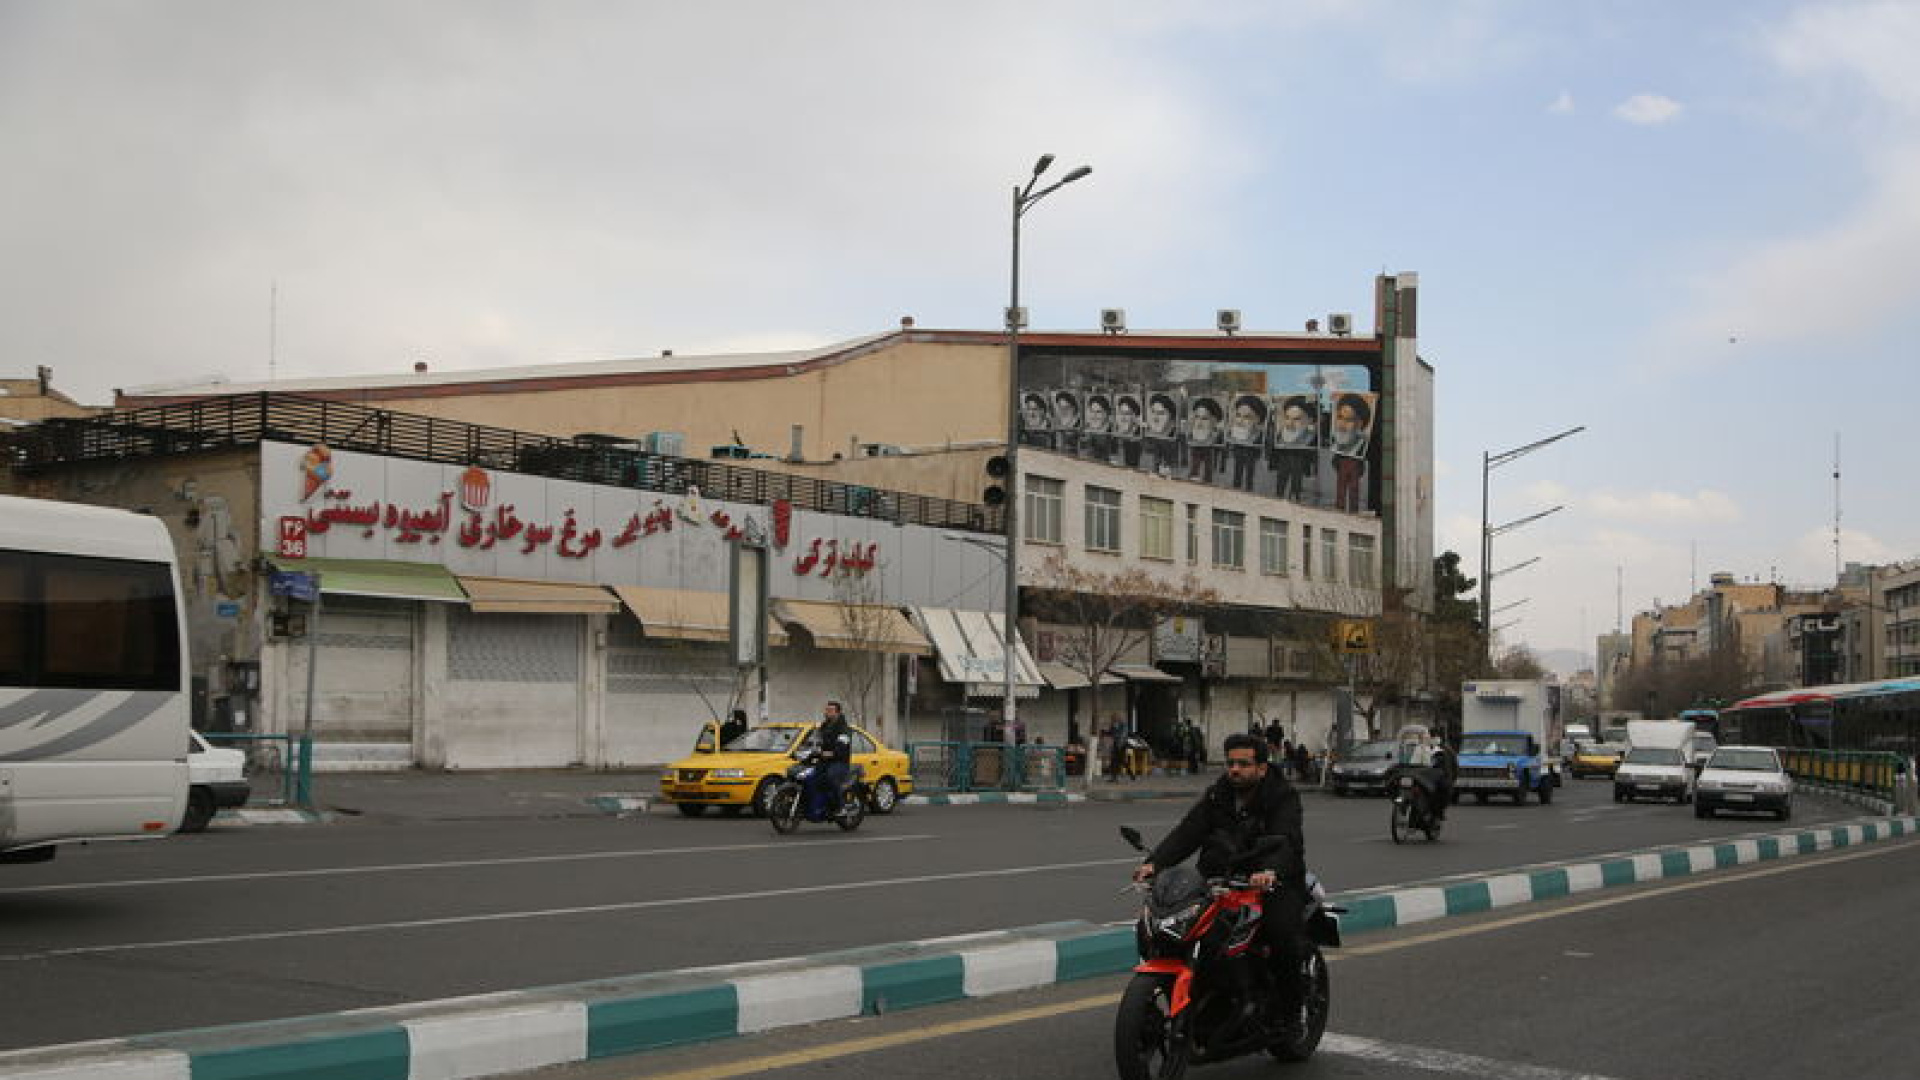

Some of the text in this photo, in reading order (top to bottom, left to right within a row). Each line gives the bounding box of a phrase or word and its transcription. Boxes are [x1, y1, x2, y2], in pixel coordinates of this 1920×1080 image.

[304, 489, 380, 540] بستنی
[458, 503, 554, 554] سوخاری
[556, 508, 602, 559] مرغ
[792, 537, 838, 577] ترکی
